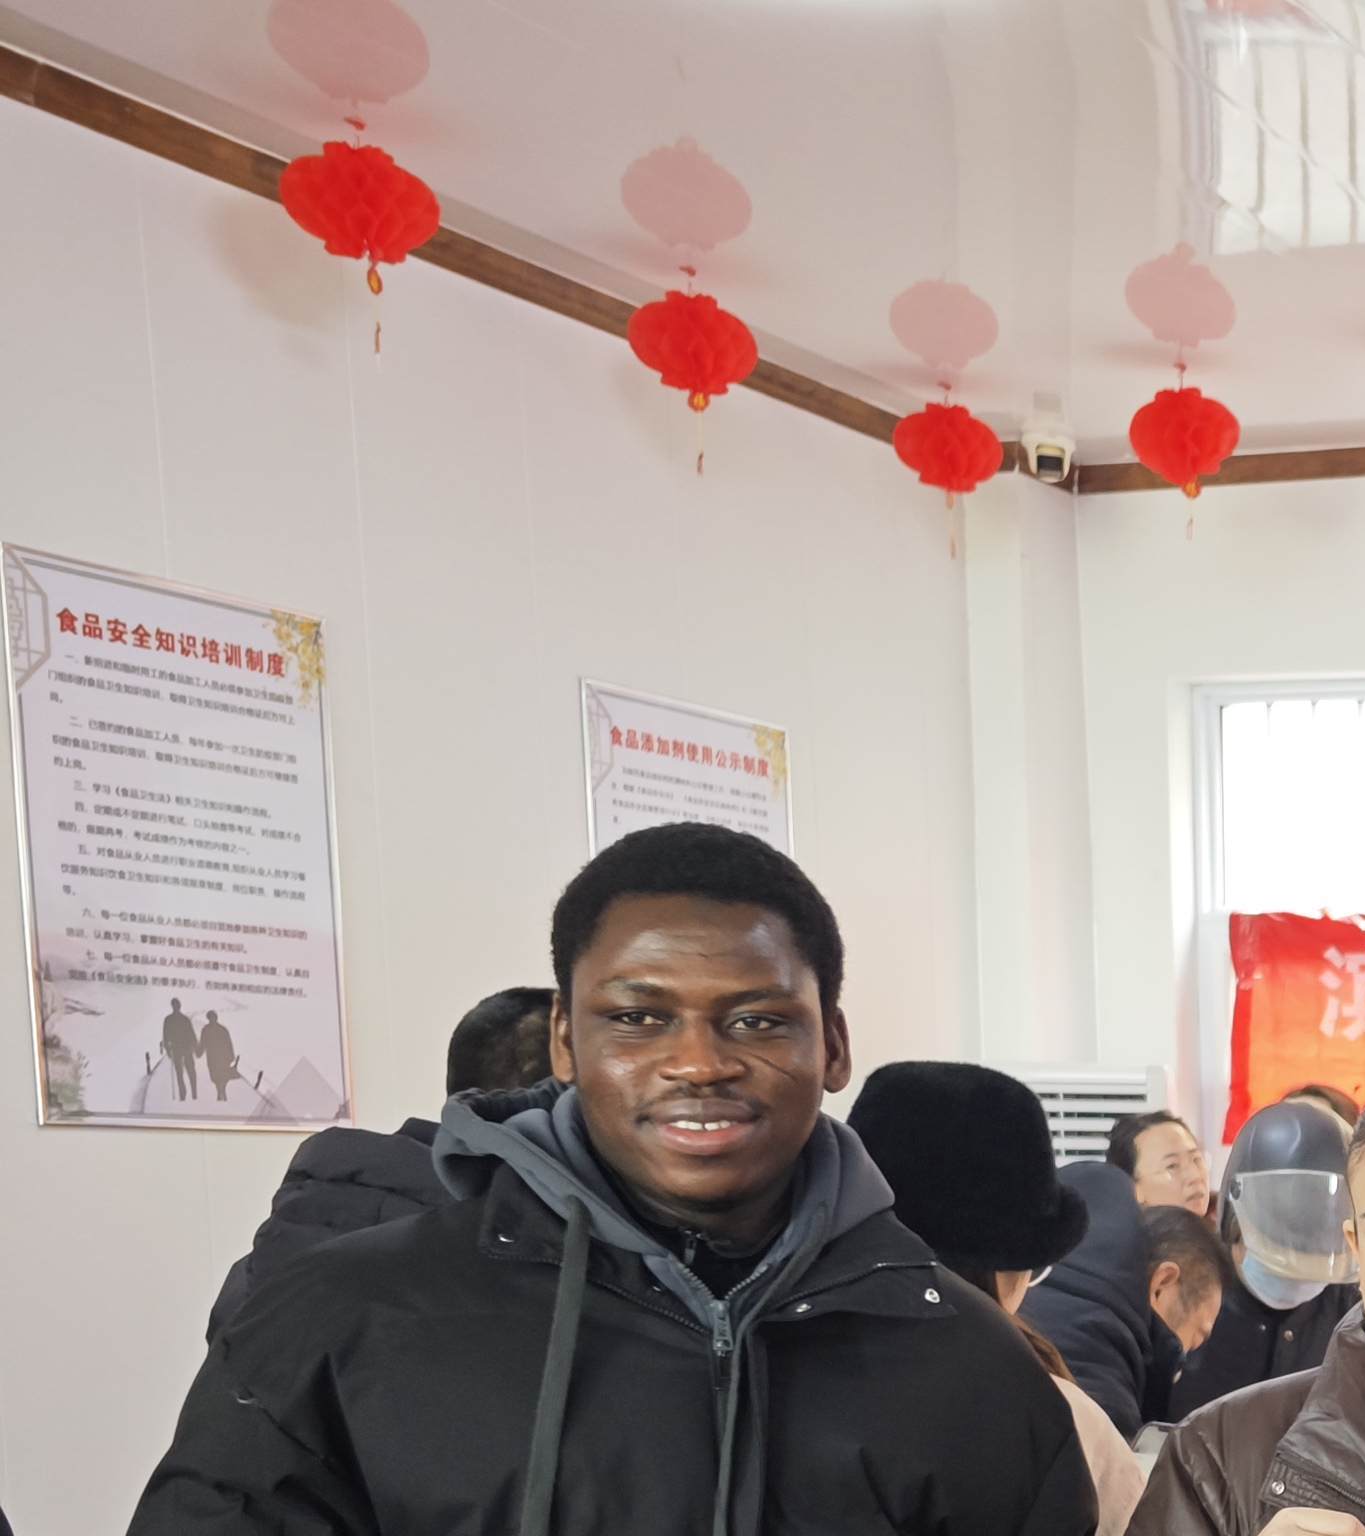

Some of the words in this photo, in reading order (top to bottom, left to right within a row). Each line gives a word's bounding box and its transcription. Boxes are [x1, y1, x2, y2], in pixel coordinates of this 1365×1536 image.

[55, 608, 287, 678] 食品安全知识培训制度
[610, 725, 769, 778] 食品添加剂使用公示制度
